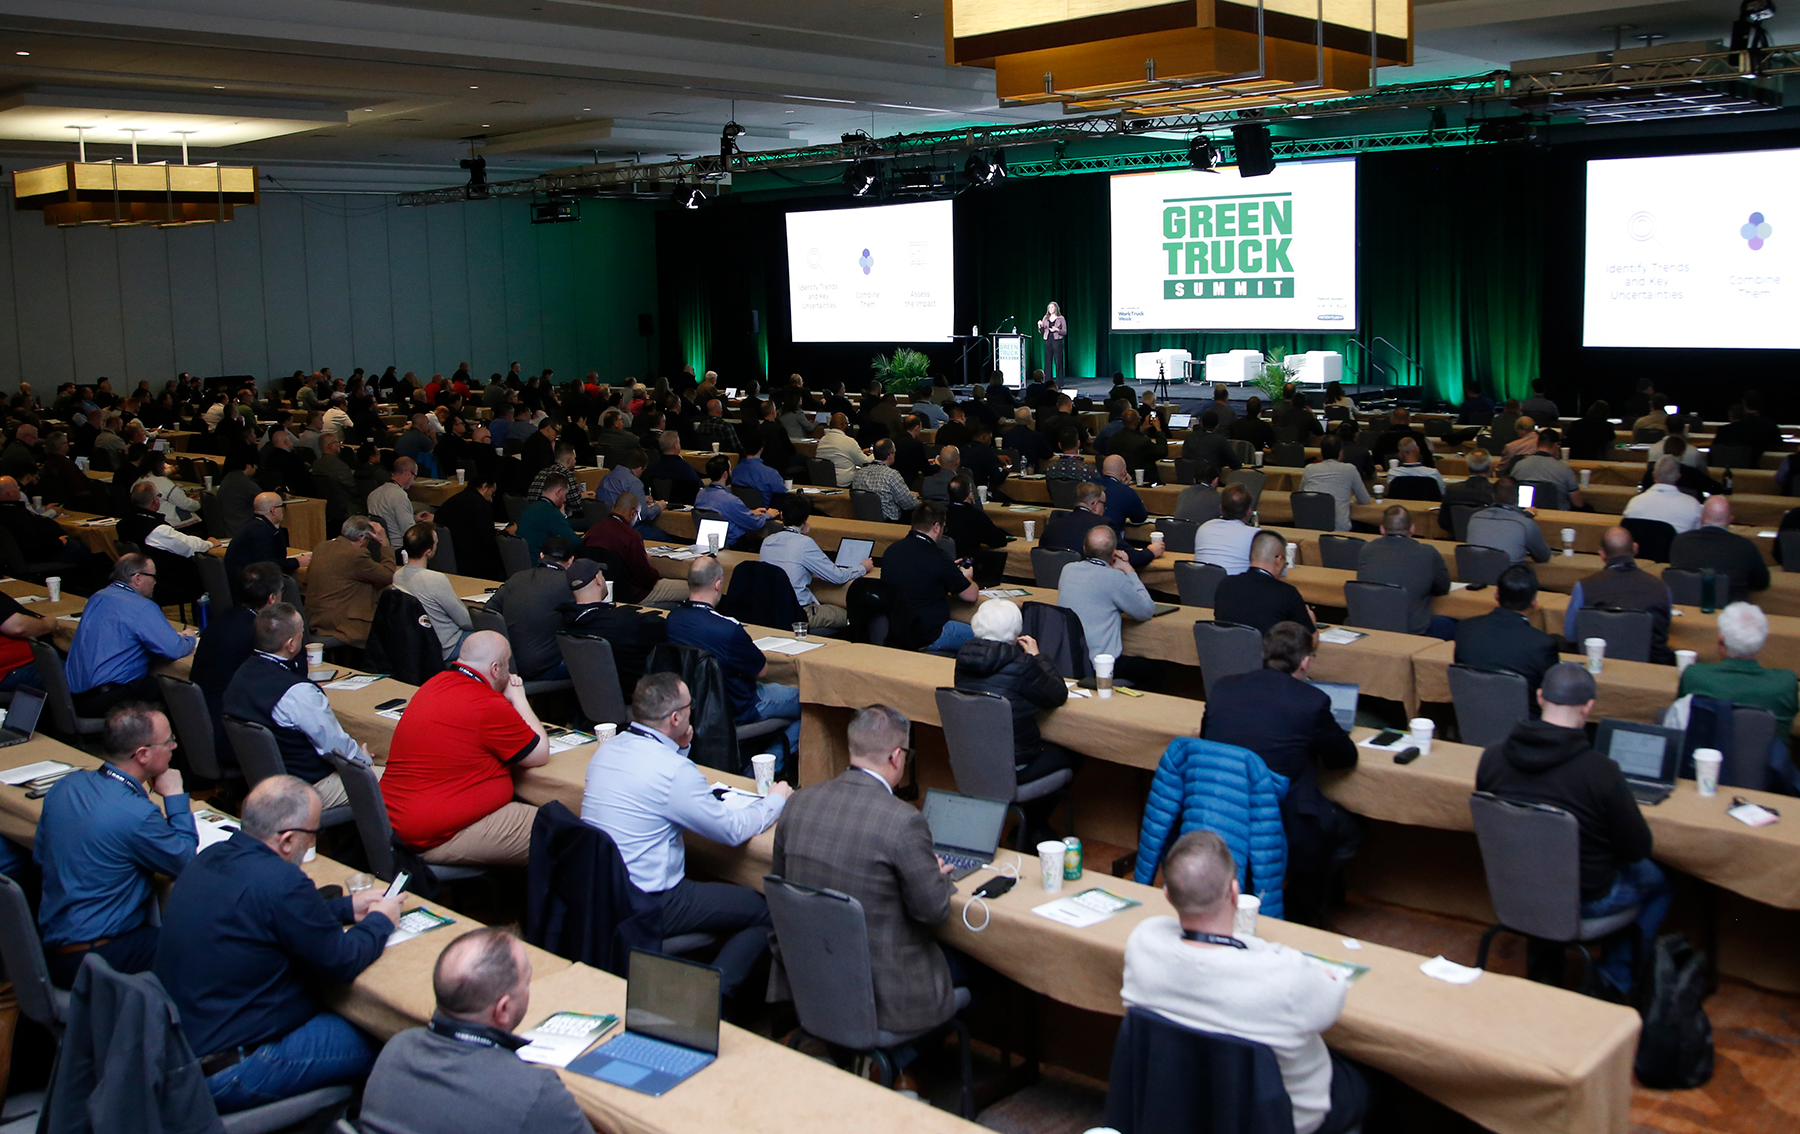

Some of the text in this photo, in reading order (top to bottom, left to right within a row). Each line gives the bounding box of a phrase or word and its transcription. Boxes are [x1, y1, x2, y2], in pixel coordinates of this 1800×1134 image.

[1163, 200, 1292, 239] GREEN
[1163, 238, 1295, 275] TRUCK
[1606, 262, 1690, 274] Identify Trends
[1625, 276, 1669, 287] and Key
[1729, 275, 1781, 285] Combine
[820, 283, 838, 291] Trends
[1174, 280, 1283, 297] SUMMIT
[856, 291, 880, 299] Combine
[910, 290, 930, 298] Assess
[1610, 290, 1684, 300] Uncertainties
[1738, 288, 1771, 299] Them
[904, 300, 936, 308] the Impact
